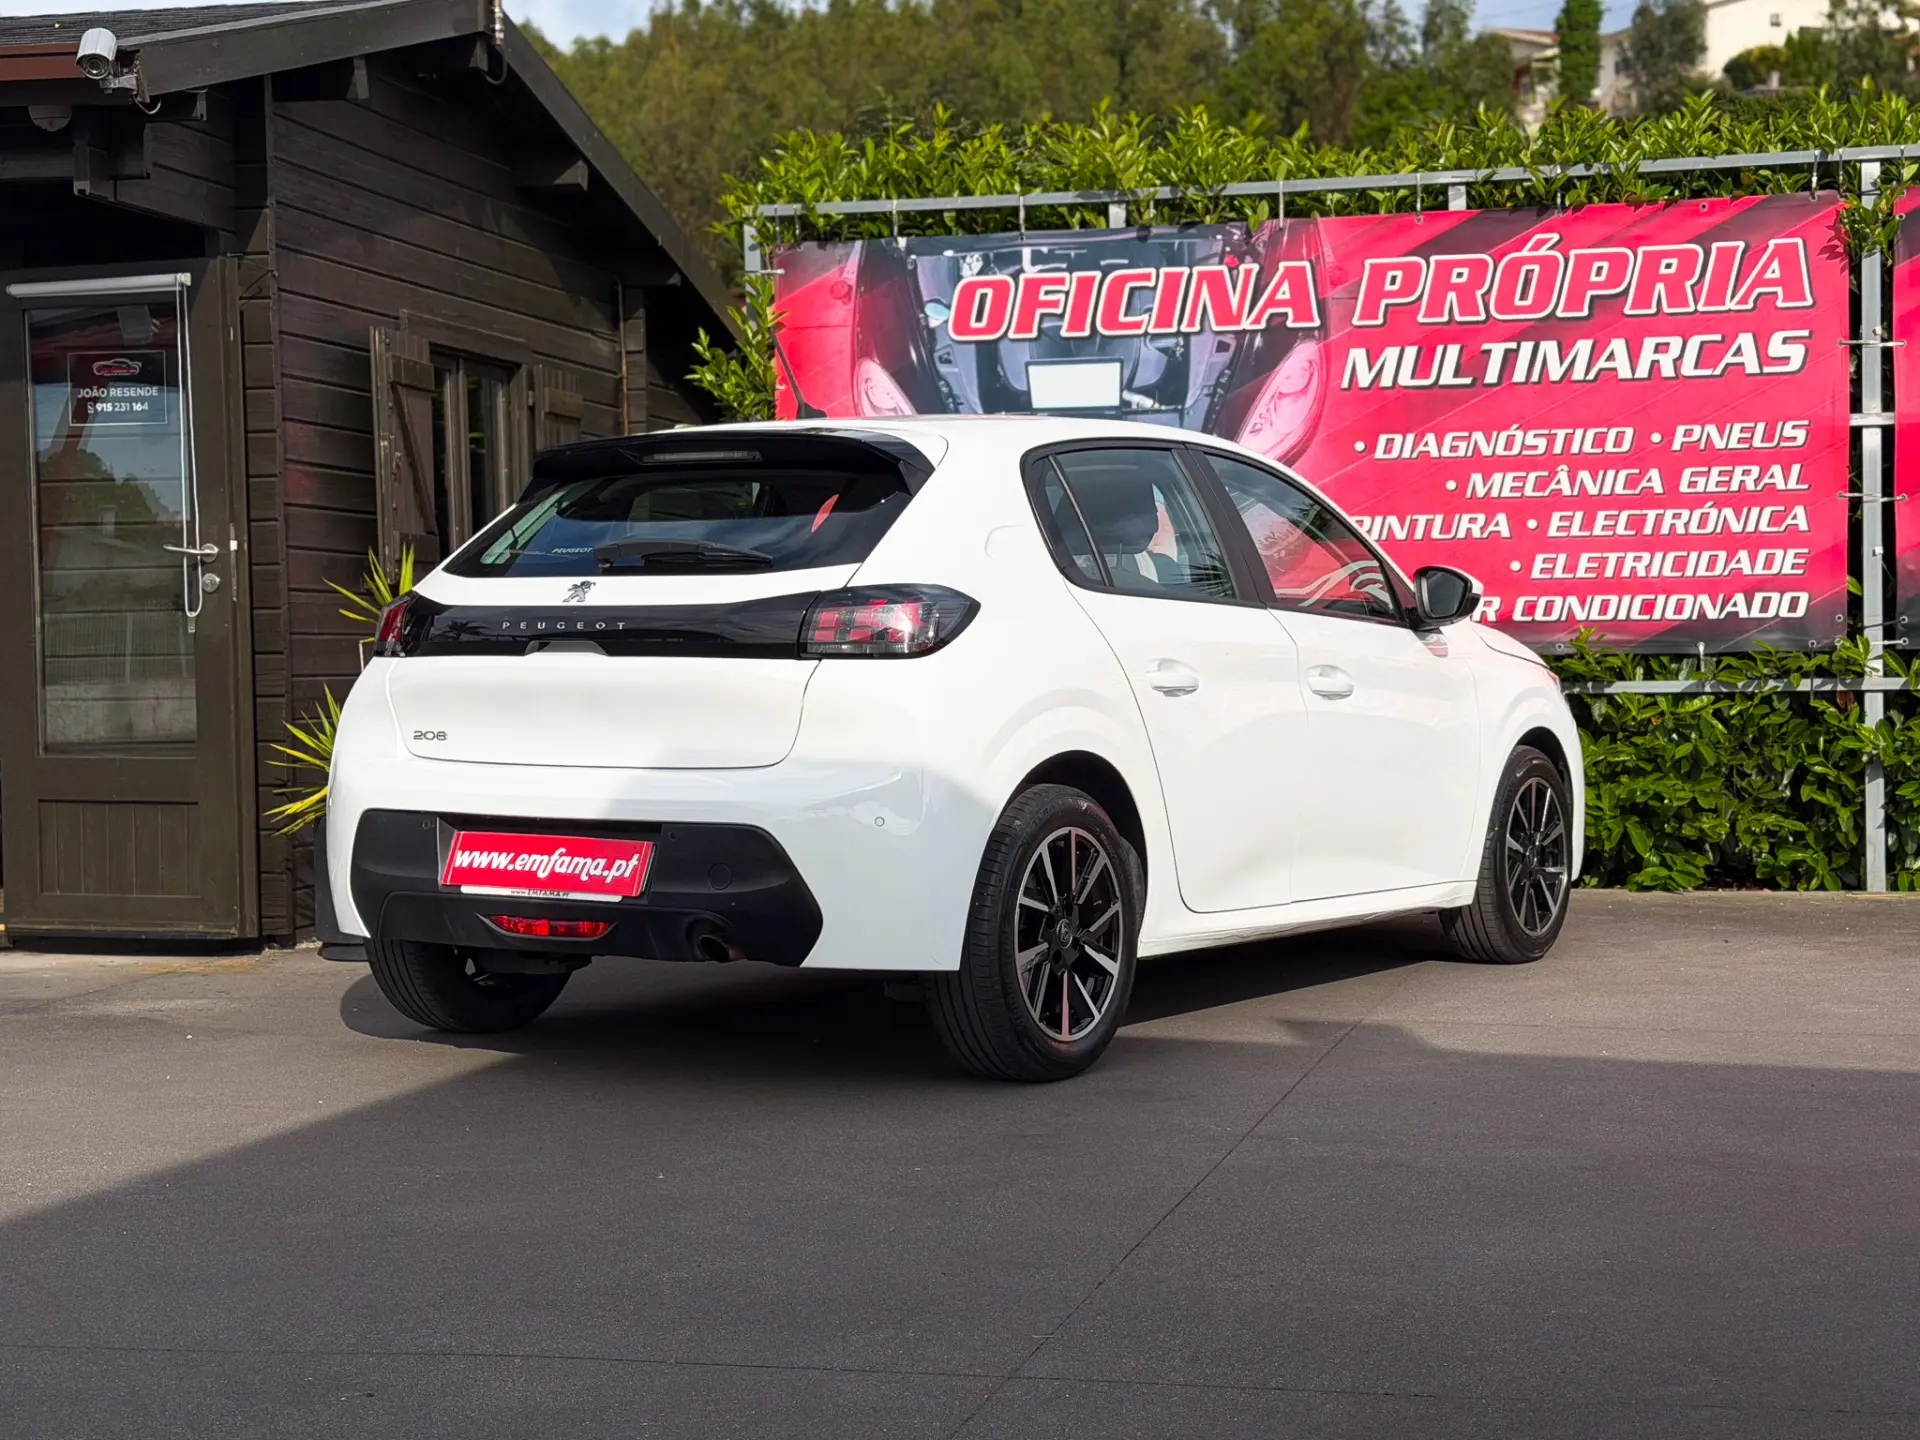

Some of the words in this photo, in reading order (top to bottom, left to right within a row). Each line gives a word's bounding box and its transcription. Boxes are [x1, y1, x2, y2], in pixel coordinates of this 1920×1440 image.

[948, 261, 1320, 341] OFICINA
[1352, 234, 1813, 327] PRÓPRIA
[1341, 330, 1811, 390] MULTIMARCAS
[77, 386, 107, 398] JOÃO
[110, 386, 159, 397] RESENDE
[96, 402, 113, 412] 915
[114, 402, 130, 412] 231
[132, 402, 149, 411] 164
[1374, 423, 1635, 461] DIAGNÓSTICO
[1671, 420, 1810, 451] PNEUS
[1465, 464, 1664, 498] MECÂNICA
[1679, 464, 1810, 494] GERAL
[1547, 504, 1809, 538] ELECTRÓNICA
[1530, 549, 1809, 580] ELETRICIDADE
[1470, 596, 1501, 622] R
[1512, 591, 1809, 622] CONDICIONADO
[502, 621, 626, 630] PEUGEOT
[454, 848, 640, 884] www.emfama.pt
